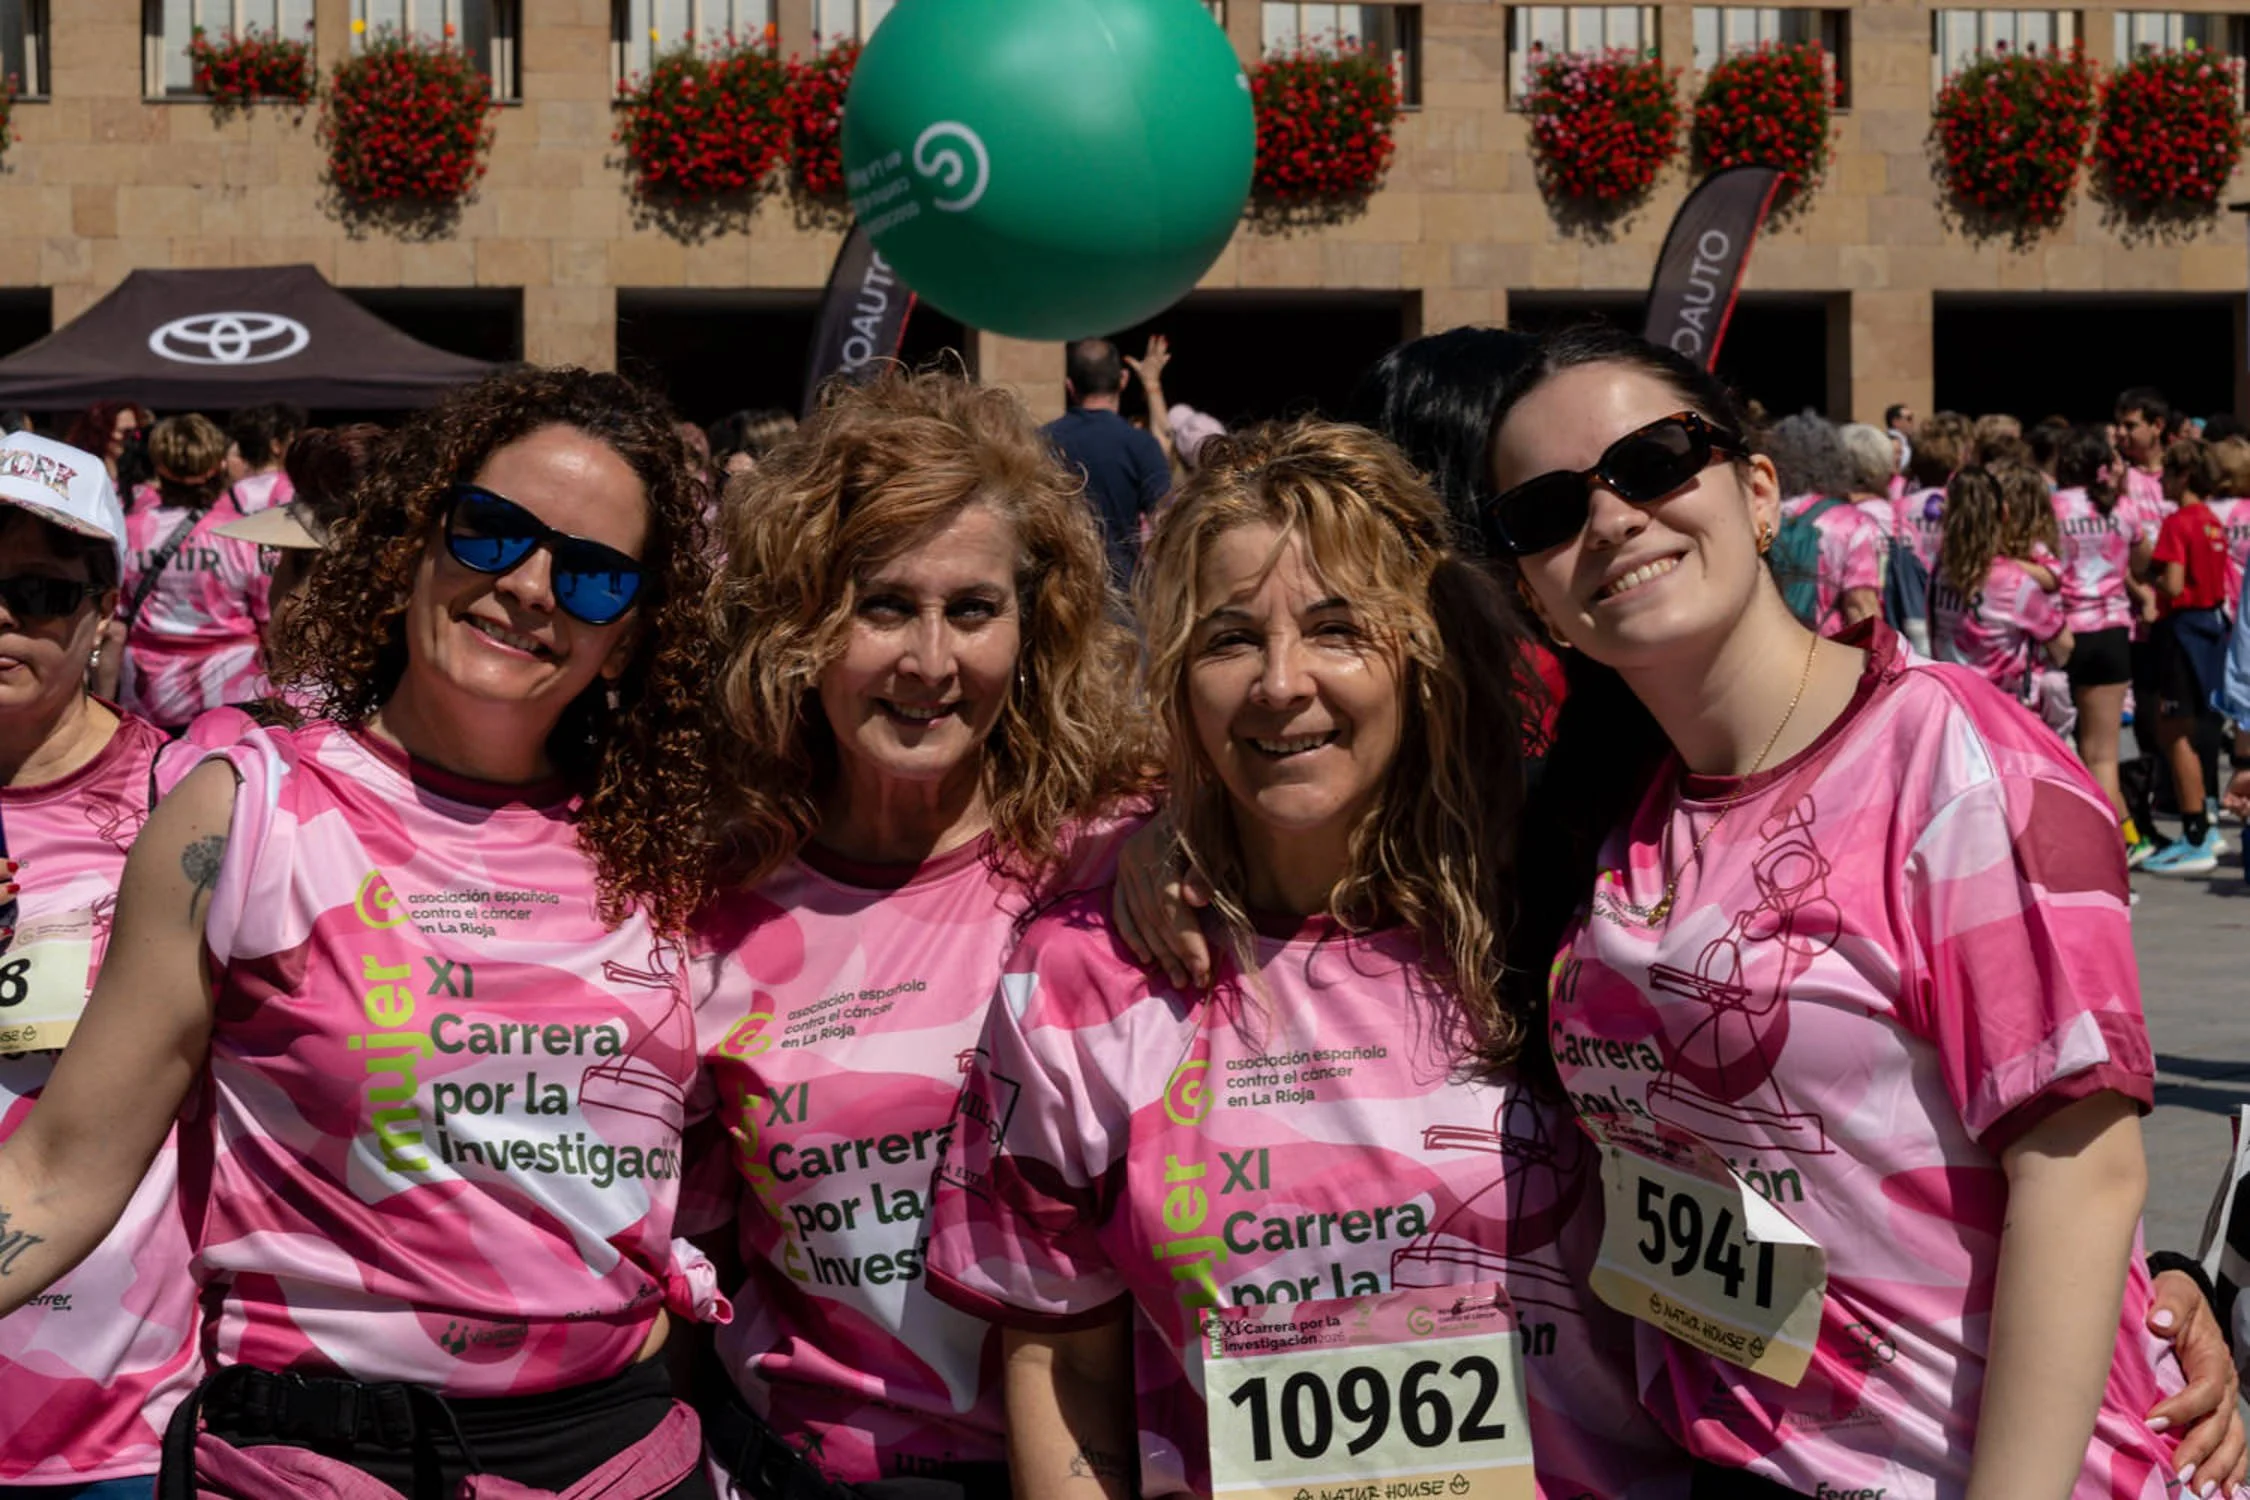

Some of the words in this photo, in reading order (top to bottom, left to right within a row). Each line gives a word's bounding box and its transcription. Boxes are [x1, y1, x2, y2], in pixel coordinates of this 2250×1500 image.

[839, 249, 893, 373] OAUT
[411, 907, 462, 920] contra
[466, 907, 478, 919] el
[481, 906, 532, 921] cáncer
[440, 924, 457, 934] La
[461, 926, 497, 938] Rioja
[424, 957, 474, 998] XI
[786, 991, 855, 1021] asociación
[829, 1011, 841, 1026] el
[843, 1001, 894, 1021] cáncer
[431, 1013, 622, 1058] Carrera
[780, 1036, 800, 1049] en
[802, 1031, 818, 1047] La
[820, 1021, 856, 1041] Rioja
[1551, 1020, 1665, 1073] Carrera
[348, 955, 437, 1173] mujer
[1226, 1051, 1311, 1071] asociación
[1313, 1044, 1388, 1065] española
[1226, 1073, 1281, 1089] contra
[1283, 1071, 1298, 1086] el
[1300, 1065, 1354, 1083] cáncer
[434, 1081, 514, 1125] por
[526, 1072, 568, 1116] la
[765, 1082, 809, 1127] XI
[1227, 1095, 1248, 1108] en
[1252, 1090, 1271, 1106] La
[1275, 1087, 1316, 1106] Rioja
[1218, 1148, 1271, 1195] XI
[788, 1194, 861, 1243] por
[871, 1183, 925, 1226] la
[1222, 1202, 1429, 1255] Carrera
[1637, 1176, 1775, 1309] 5941
[28, 1293, 72, 1306] errer
[1231, 1277, 1320, 1306] por
[1334, 1262, 1381, 1298] la
[1224, 1334, 1318, 1354] investigación
[1243, 1321, 1297, 1336] Carrera
[1300, 1319, 1325, 1334] por
[1228, 1355, 1506, 1462] 10962
